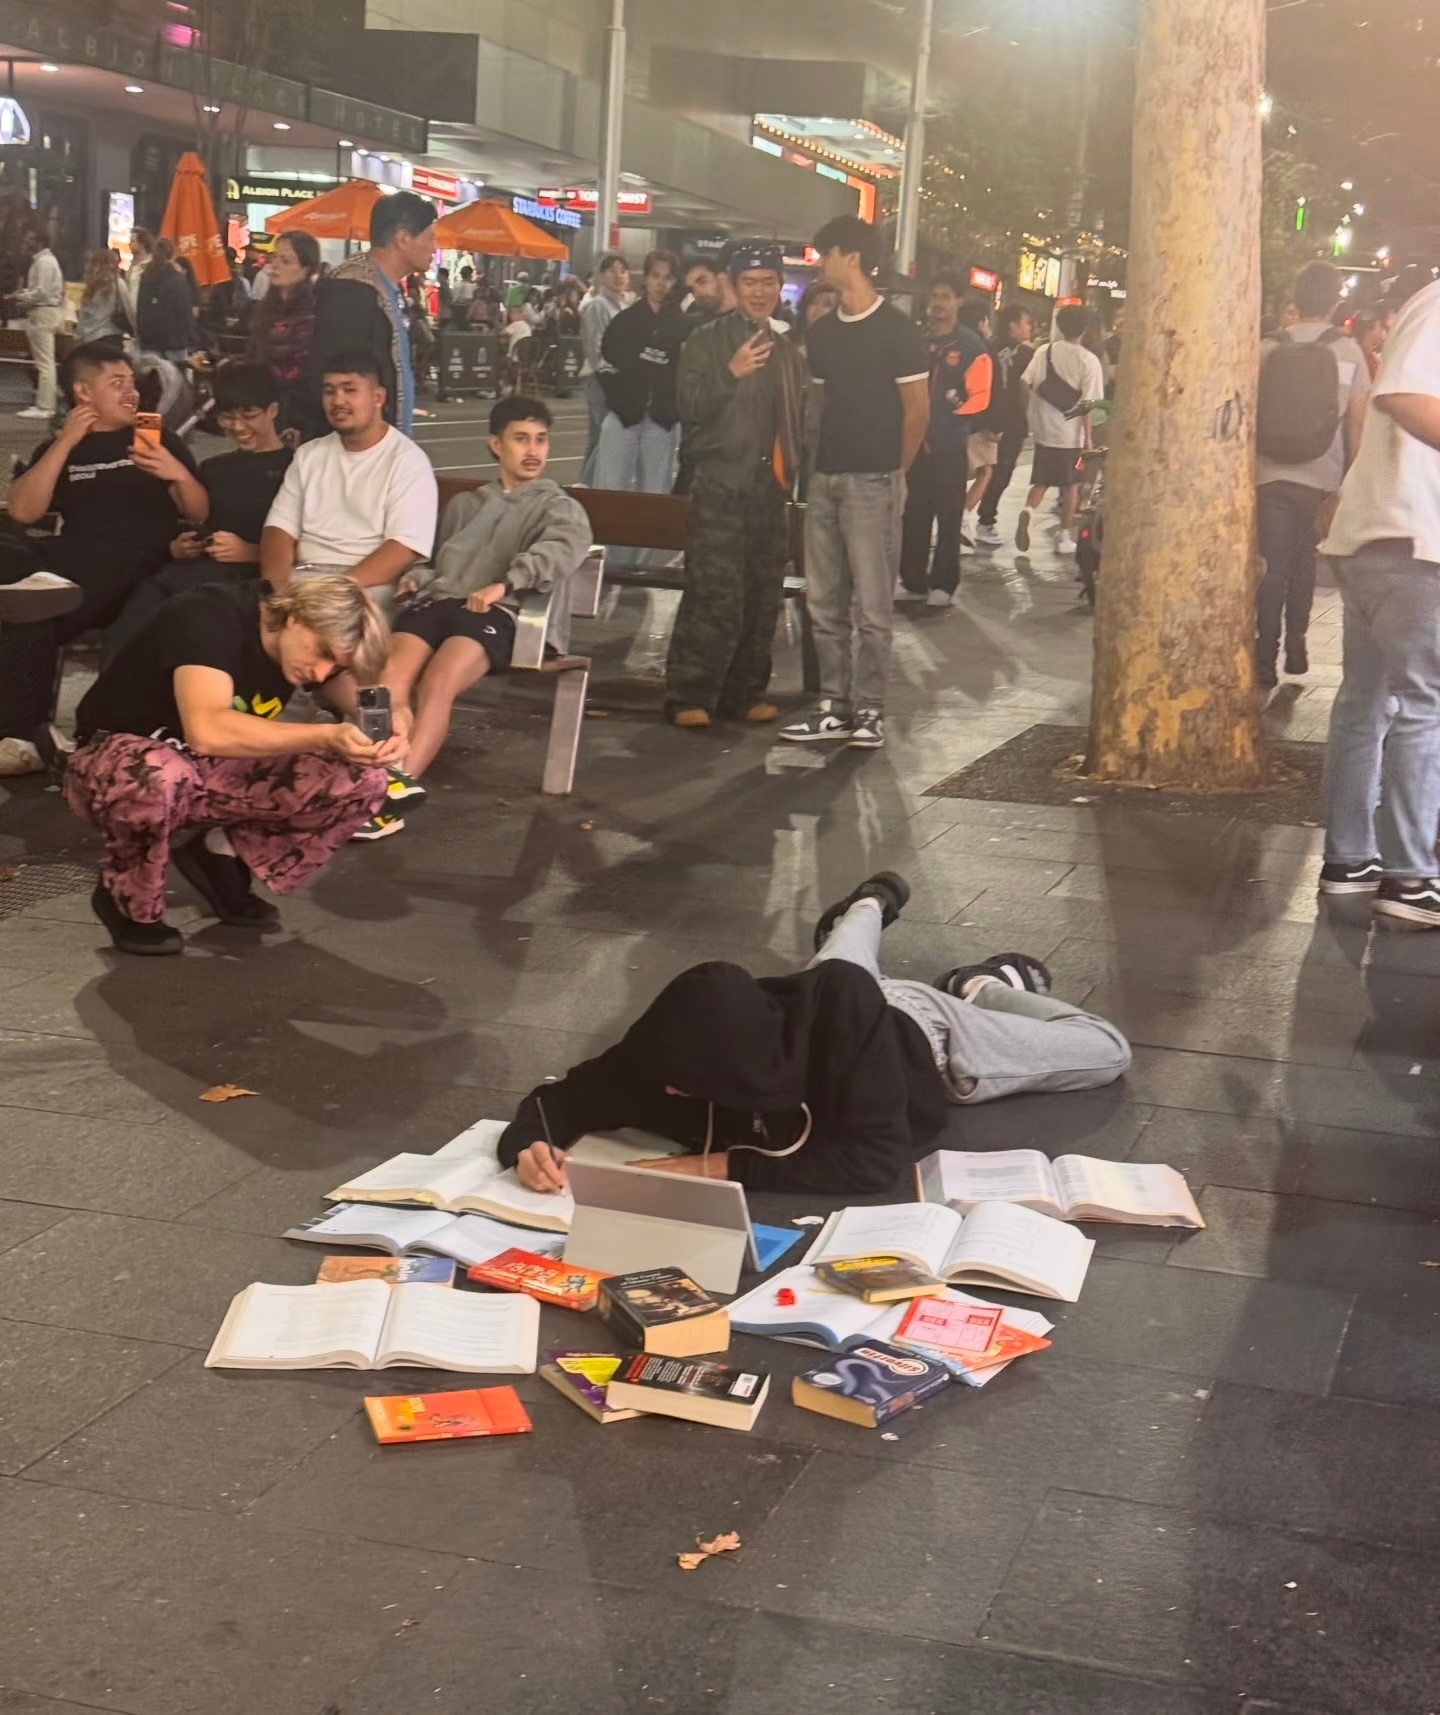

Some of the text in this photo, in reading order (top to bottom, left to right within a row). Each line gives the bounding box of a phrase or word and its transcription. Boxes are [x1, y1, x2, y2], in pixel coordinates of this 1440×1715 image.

[335, 105, 420, 143] HOTEL
[512, 196, 582, 229] STARBUCKS COFFEE
